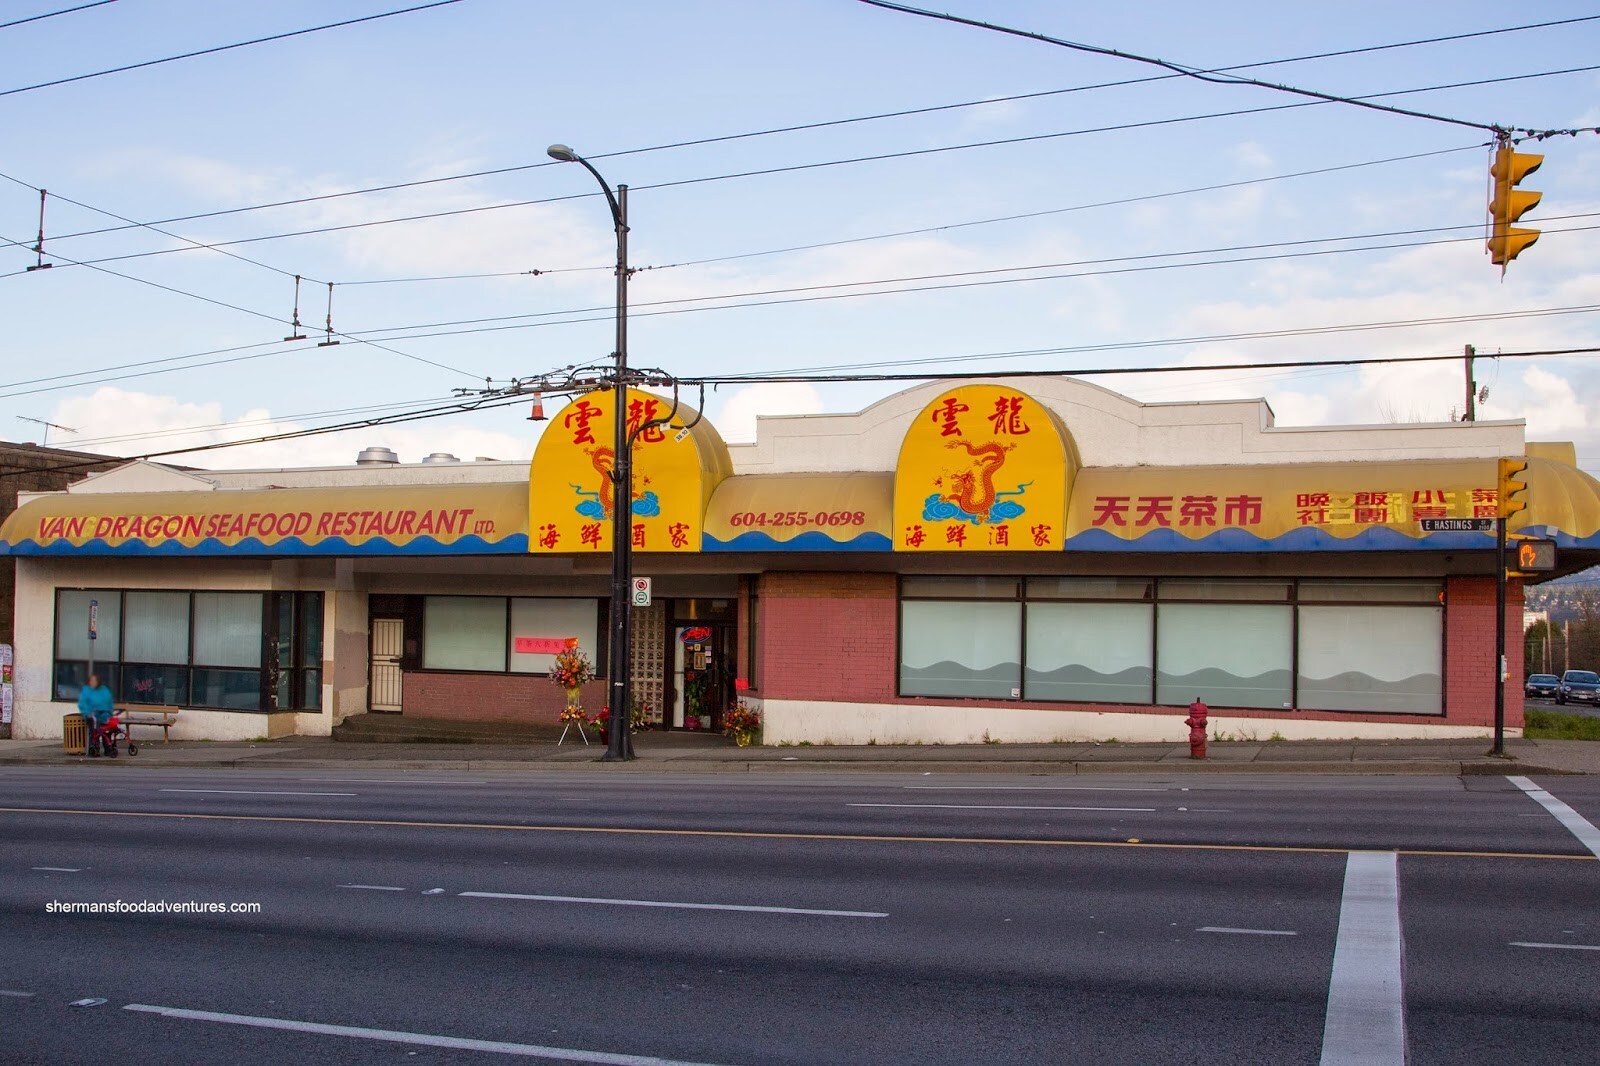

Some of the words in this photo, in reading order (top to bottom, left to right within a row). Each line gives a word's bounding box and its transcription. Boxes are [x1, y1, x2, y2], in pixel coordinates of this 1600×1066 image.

[931, 396, 1031, 437] 雲龍
[38, 516, 88, 539] VAN
[94, 514, 206, 538] DRAGON
[205, 511, 313, 537] SEAFOOD
[316, 508, 475, 536] RESTAURANT
[473, 520, 496, 534] LTD.
[730, 511, 866, 527] 604-255-0698
[1091, 494, 1263, 526] 天天茶市
[905, 523, 1052, 548] 海鮮酒家
[1425, 520, 1431, 530] E
[1434, 520, 1472, 530] HASTINGS
